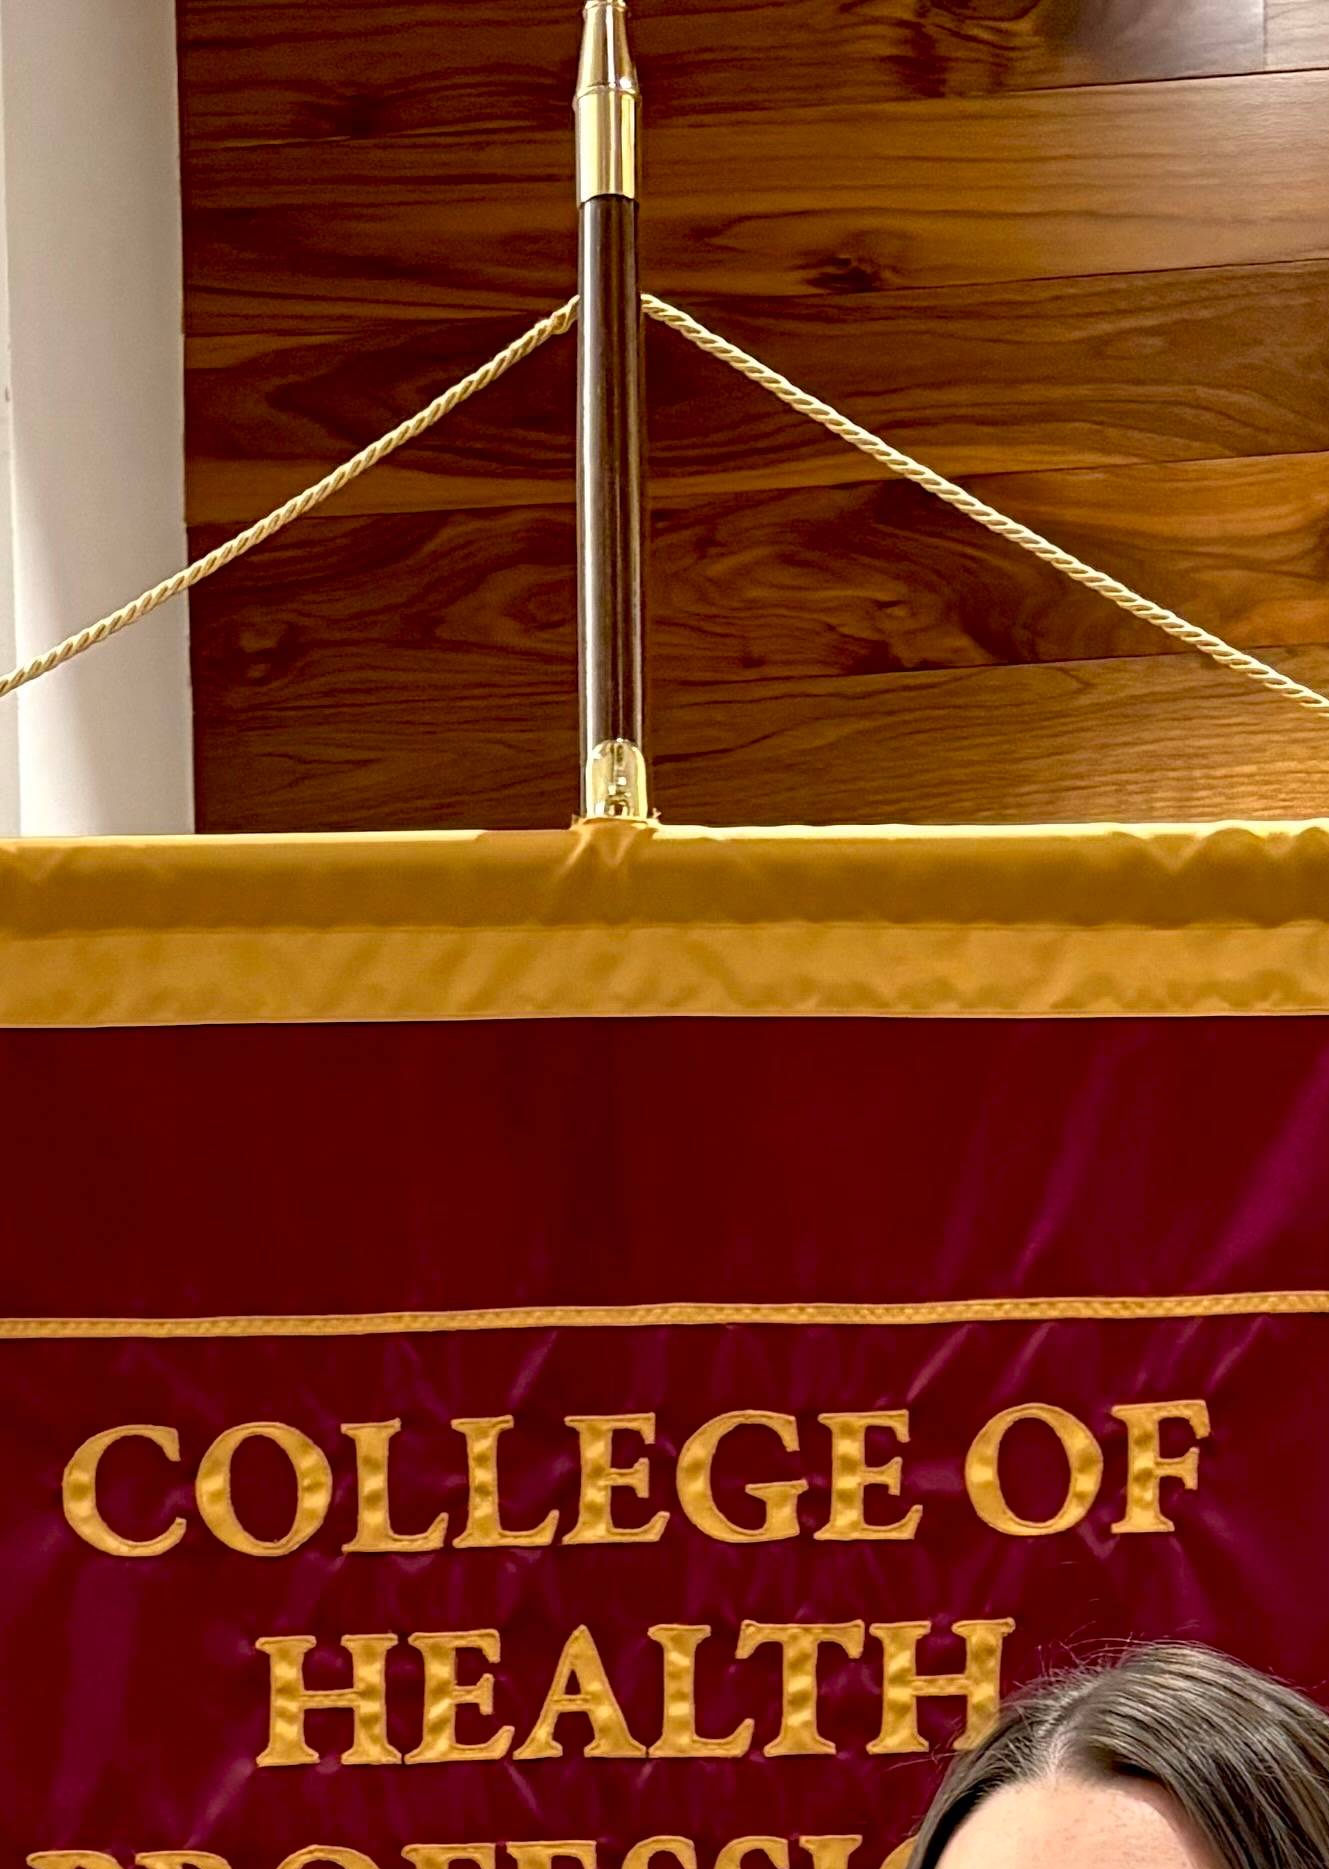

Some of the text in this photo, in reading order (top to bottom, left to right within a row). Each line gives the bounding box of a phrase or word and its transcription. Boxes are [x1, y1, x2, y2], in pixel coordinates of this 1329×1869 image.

[62, 1400, 1211, 1557] COLLEGE OF
[255, 1618, 1015, 1767] HEALTH
